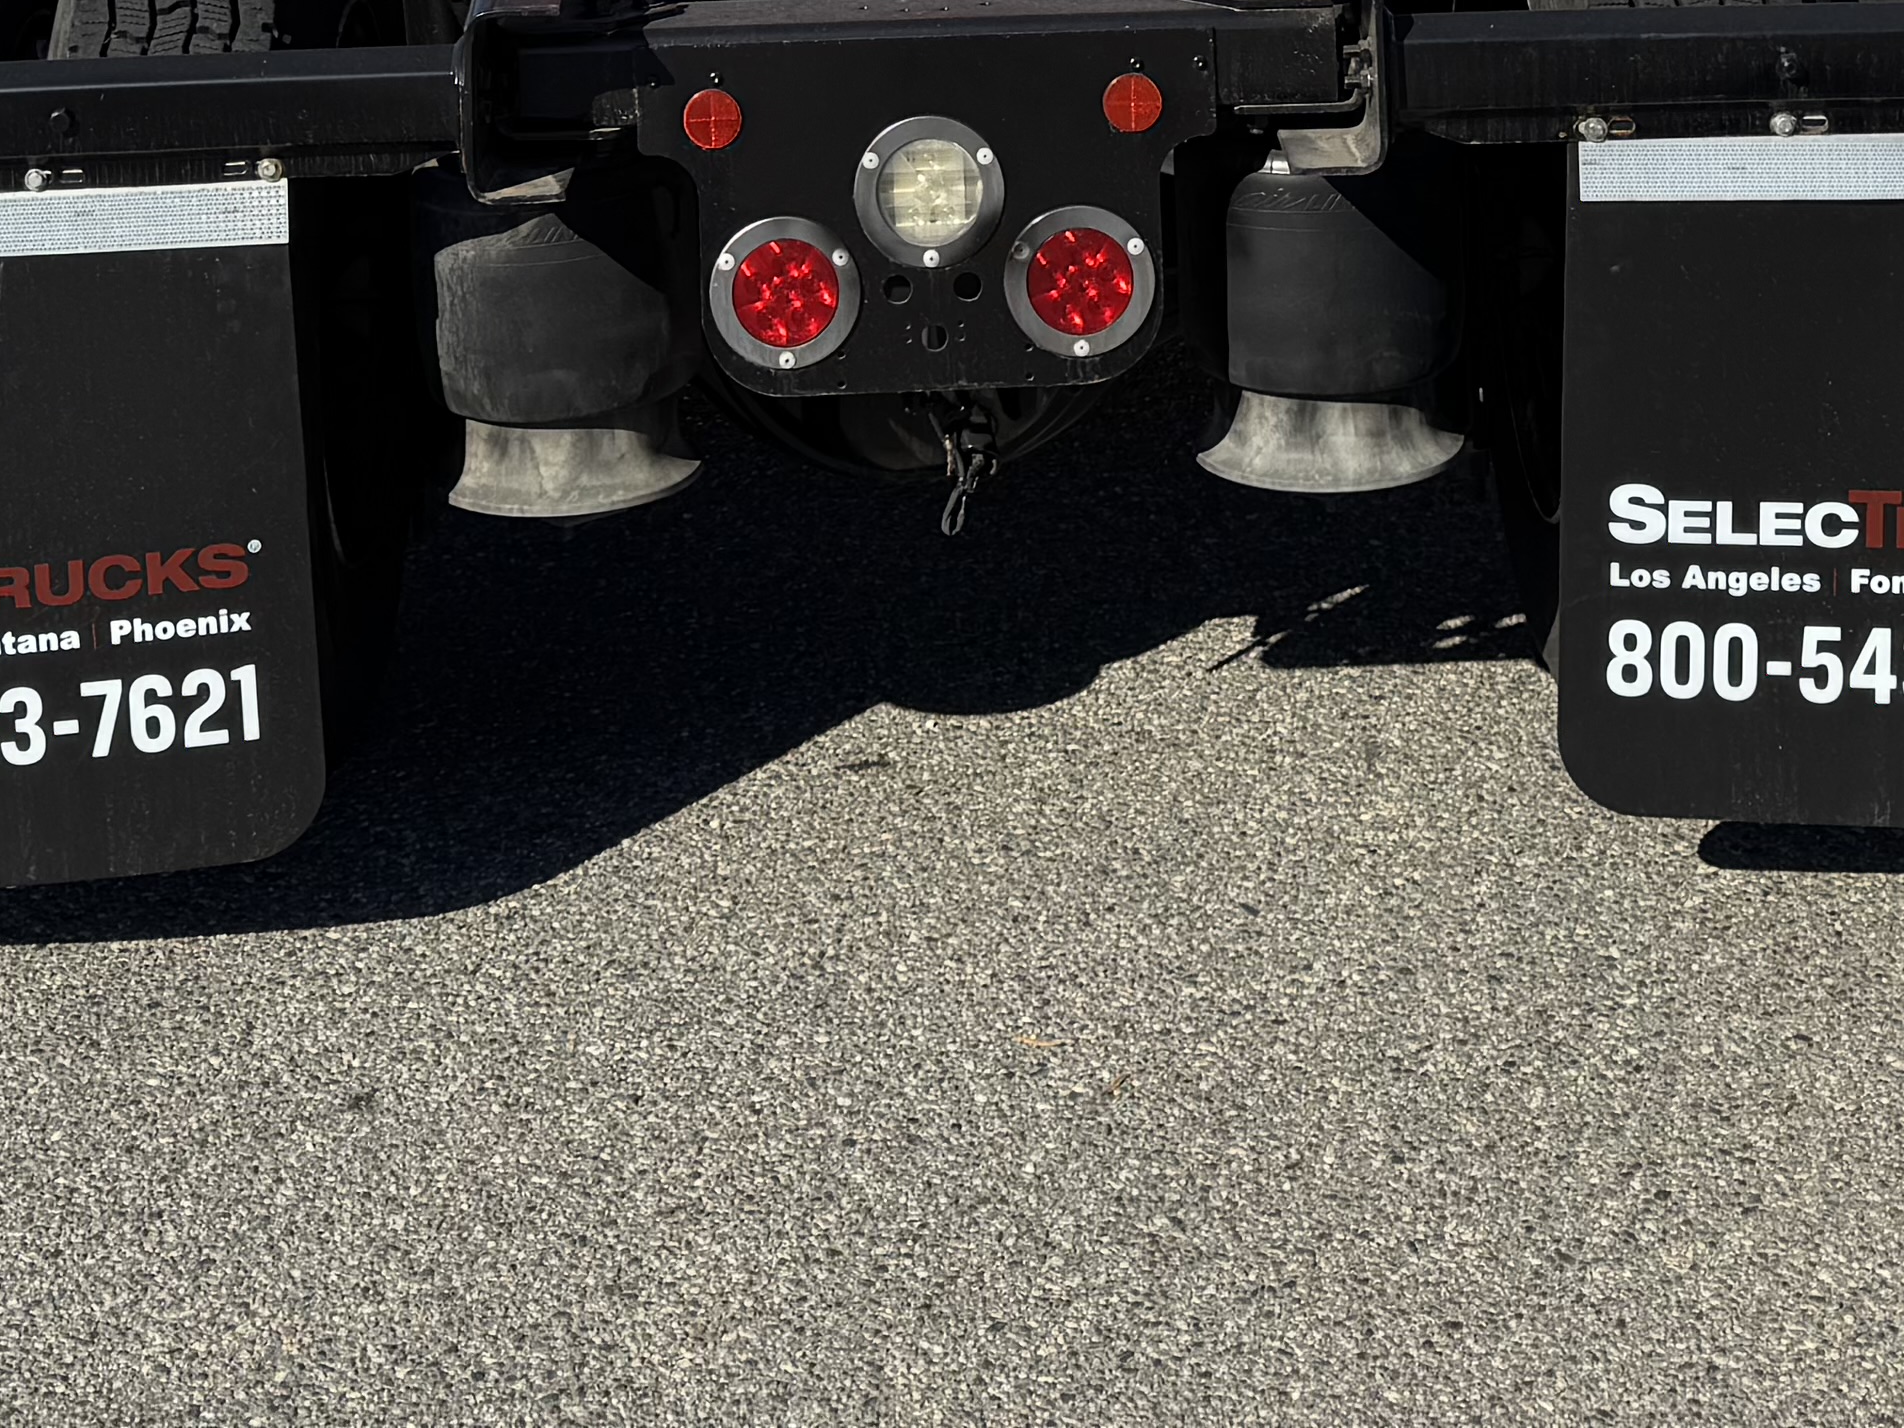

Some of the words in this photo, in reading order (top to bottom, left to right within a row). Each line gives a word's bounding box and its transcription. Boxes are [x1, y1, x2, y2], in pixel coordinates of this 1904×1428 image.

[1610, 561, 1671, 589] Los
[1682, 565, 1821, 597] Angeles
[110, 608, 252, 646] Phoenix
